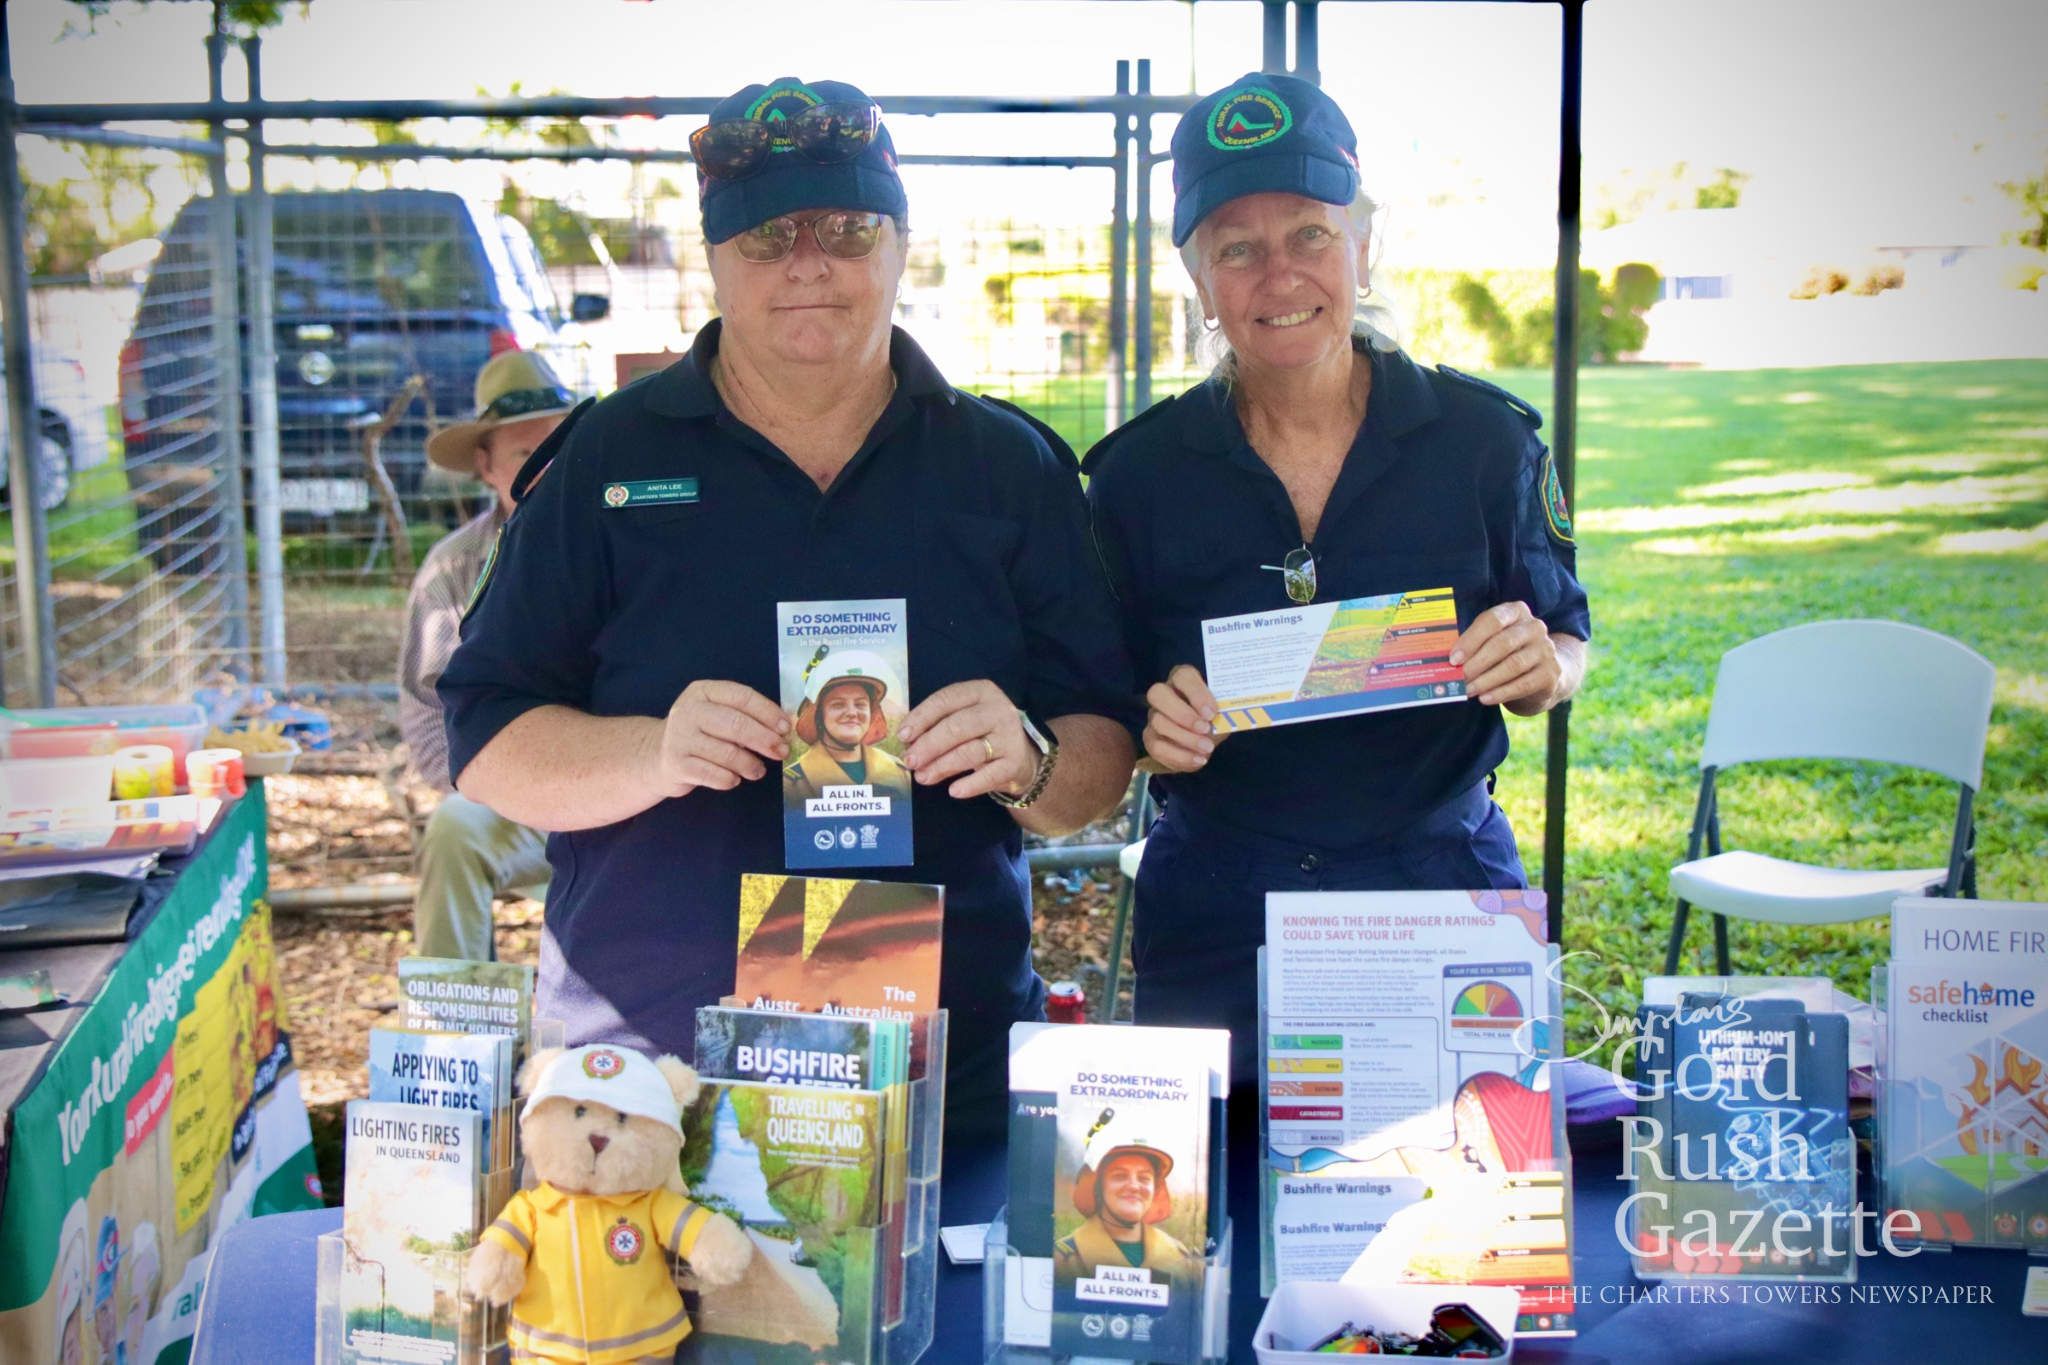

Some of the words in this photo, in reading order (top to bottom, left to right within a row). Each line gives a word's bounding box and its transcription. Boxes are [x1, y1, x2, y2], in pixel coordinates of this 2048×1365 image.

[1233, 94, 1254, 104] FIRE
[792, 614, 812, 625] DO
[814, 612, 891, 624] SOMETHING
[1207, 621, 1252, 635] Bushfire
[1253, 614, 1304, 628] Warnings
[786, 623, 898, 636] EXTRAORDINARY
[808, 638, 822, 646] the
[823, 637, 842, 646] Rural
[843, 637, 858, 645] Fire
[859, 636, 886, 645] Service
[829, 789, 850, 800] ALL
[852, 789, 868, 799] IN.
[812, 802, 834, 813] ALL
[835, 801, 885, 812] FRONTS.
[1283, 915, 1339, 926] KNOWING
[1342, 915, 1364, 926] THE
[1367, 915, 1392, 926] FIRE
[1394, 915, 1441, 926] DANGER
[1445, 915, 1496, 926] RATINGS
[1283, 930, 1322, 941] COULD
[1325, 930, 1354, 941] SAVE
[1357, 930, 1390, 941] YOUR
[1392, 930, 1416, 941] LIFE
[1924, 929, 2000, 952] HOME
[2009, 931, 2046, 953] FIR
[1495, 966, 1517, 974] TODAY
[407, 980, 490, 1001] OBLIGATIONS
[492, 987, 519, 1004] AND
[883, 986, 916, 1003] The
[407, 1000, 519, 1023] RESPONSIBILITIES
[1922, 1007, 1989, 1023] checklist
[1698, 1029, 1784, 1046] LITHIUM-ION
[736, 1045, 861, 1081] BUSHFIRE
[1711, 1047, 1771, 1064] BATTERY
[392, 1052, 457, 1083] APPLYING
[460, 1059, 479, 1086] TO
[1716, 1065, 1767, 1080] SAFETY
[1077, 1072, 1098, 1083] DO
[1100, 1073, 1183, 1088] SOMETHING
[400, 1086, 438, 1106] LIGHT
[1070, 1085, 1189, 1101] EXTRAORDINARY
[768, 1095, 852, 1120] TRAVELLING
[854, 1103, 865, 1116] IN
[1016, 1103, 1038, 1116] Are
[352, 1117, 418, 1142] LIGHTING
[422, 1124, 460, 1147] FIRES
[766, 1117, 864, 1149] QUEENSLAND
[376, 1145, 387, 1156] IN
[389, 1146, 460, 1164] QUEENSLAND
[1283, 1183, 1333, 1195] Bushfire
[1335, 1182, 1392, 1196] Warnings
[1280, 1223, 1330, 1234] Bushfire
[1332, 1221, 1388, 1234] Warnings
[1102, 1271, 1125, 1282] ALL
[1127, 1273, 1144, 1283] IN.
[1083, 1283, 1107, 1295] ALL
[1109, 1285, 1162, 1299] FRONTS.
